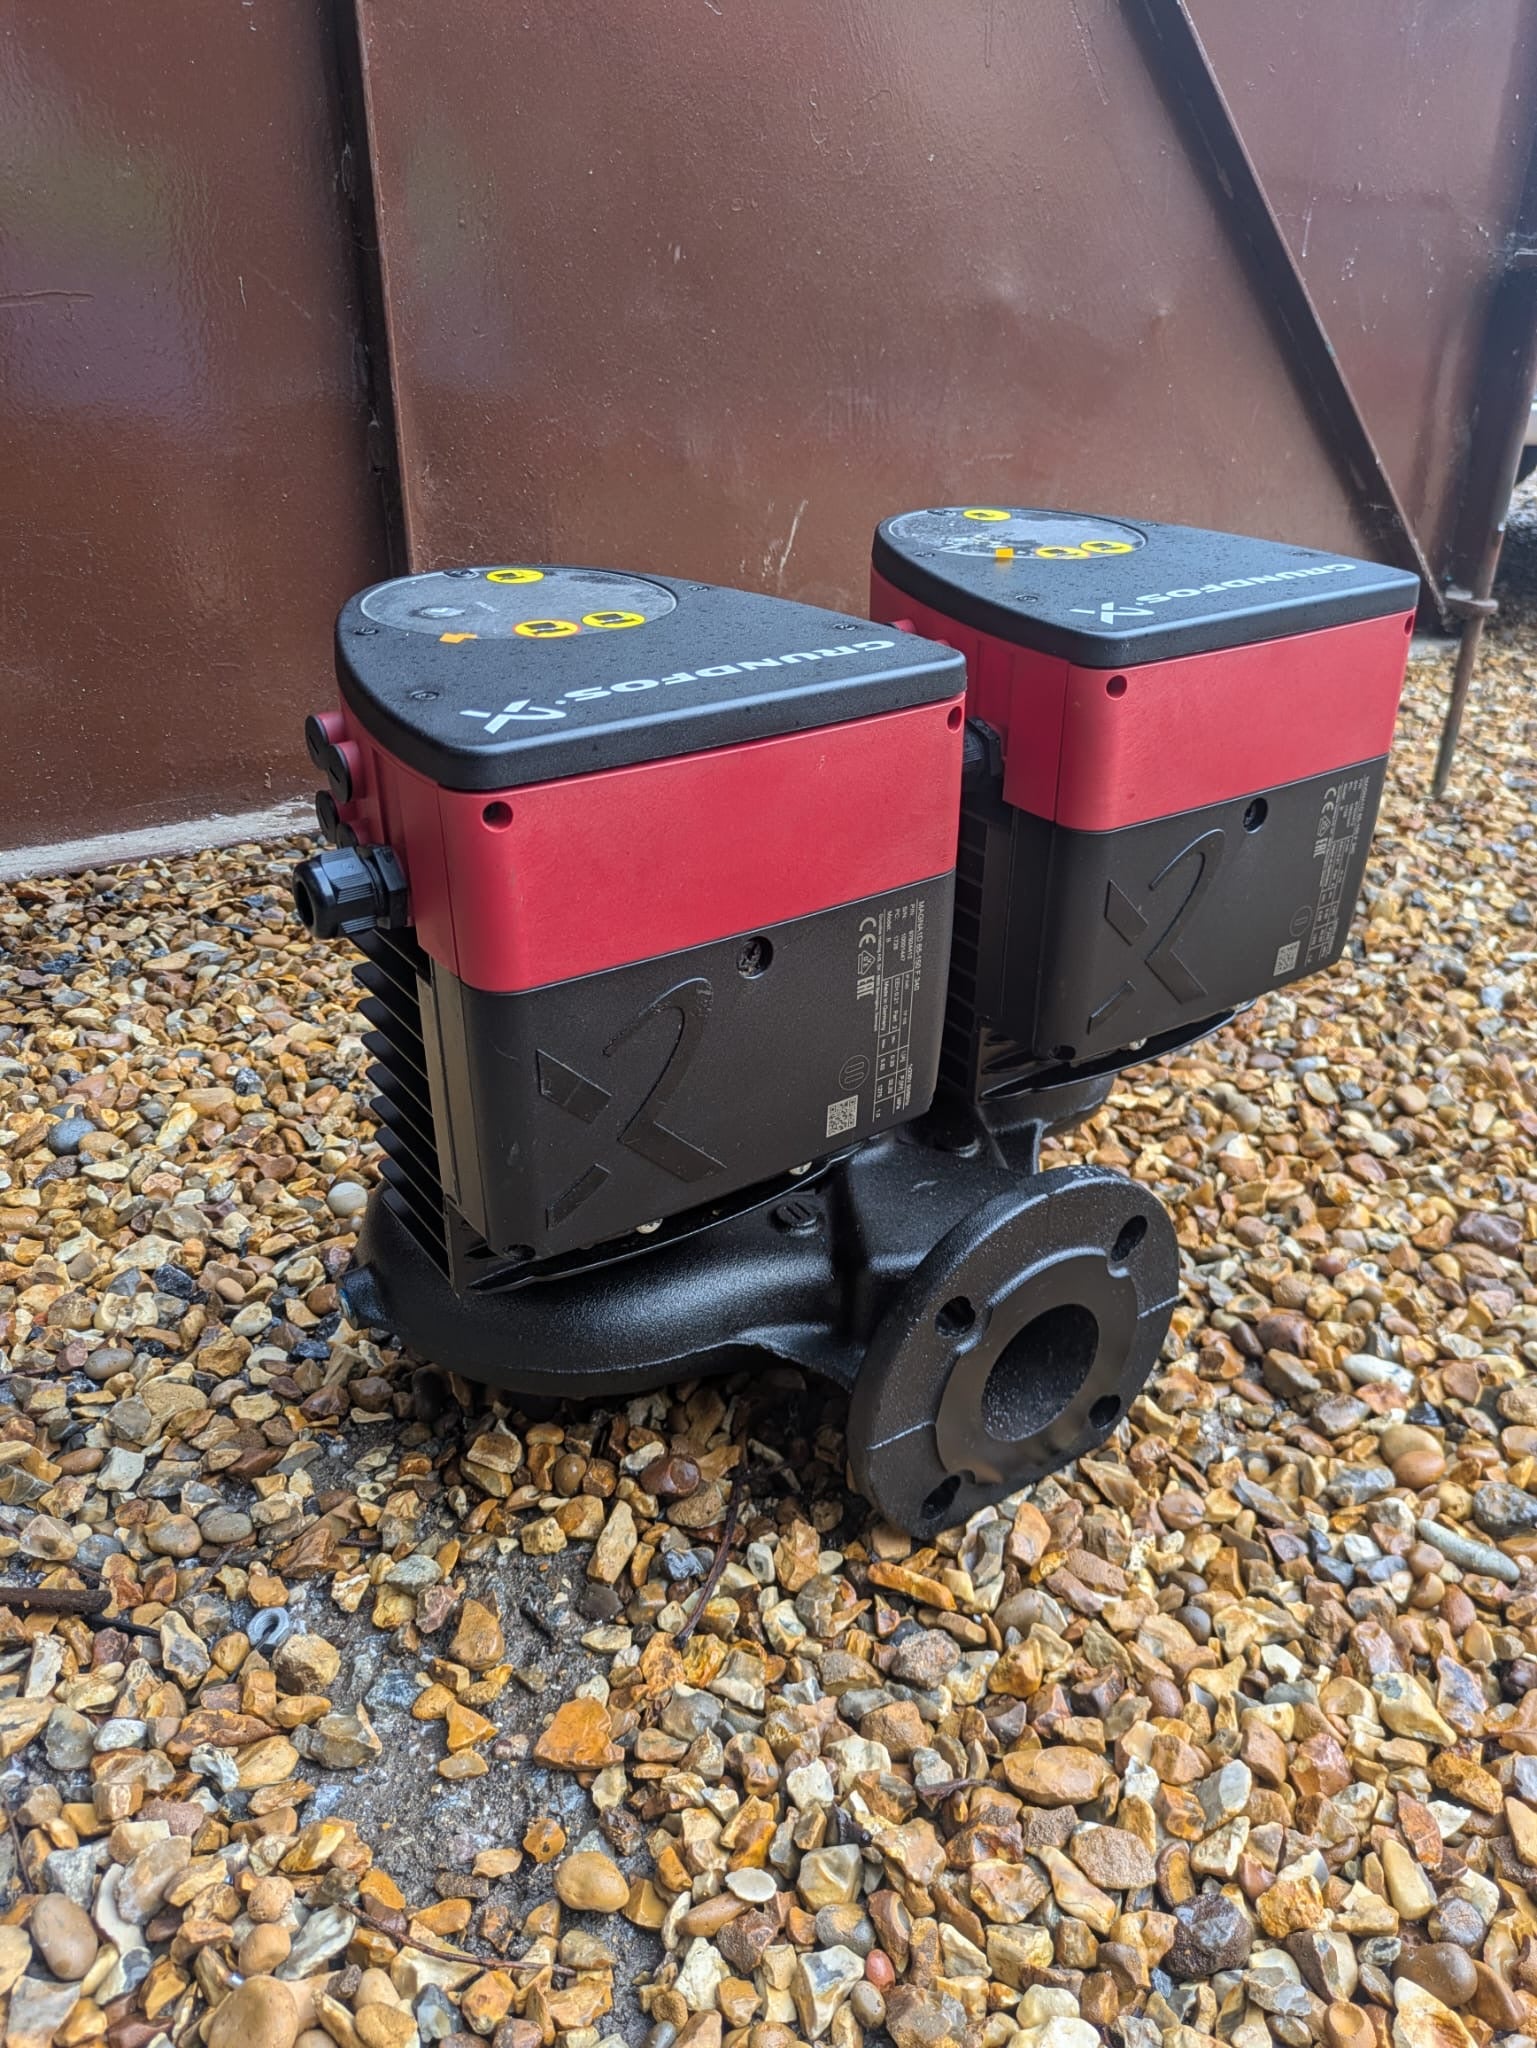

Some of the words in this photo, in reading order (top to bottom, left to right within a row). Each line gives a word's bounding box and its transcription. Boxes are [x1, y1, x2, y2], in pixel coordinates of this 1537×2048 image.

[1136, 563, 1357, 604] GRUNDFOS
[564, 640, 896, 702] GRUNDFOS
[859, 917, 877, 948] CE
